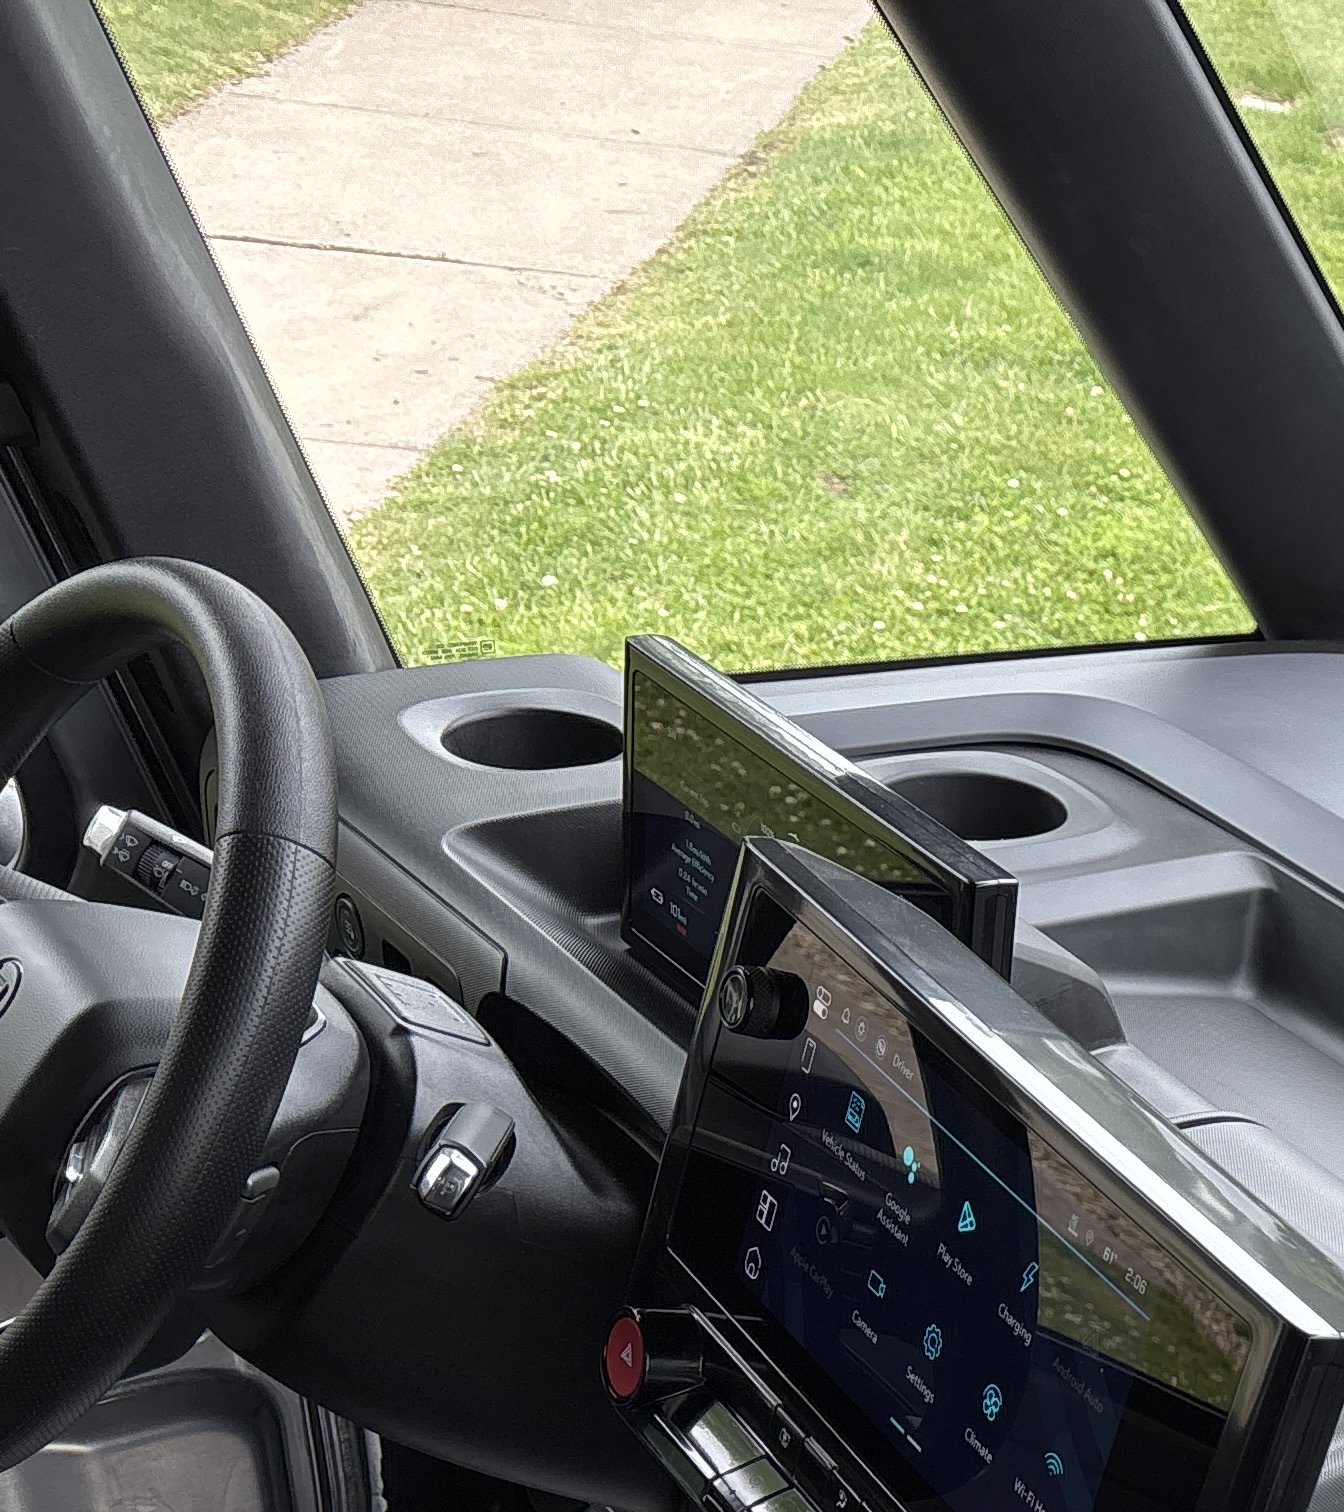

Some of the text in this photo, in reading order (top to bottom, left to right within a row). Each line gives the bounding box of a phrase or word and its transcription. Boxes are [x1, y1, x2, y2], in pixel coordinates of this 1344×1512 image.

[893, 1054, 914, 1081] Driver
[822, 1128, 867, 1182] Vehicle Status
[876, 1208, 909, 1248] Assistant
[885, 1192, 911, 1226] Google
[937, 1242, 973, 1287] Play Store
[1124, 1267, 1148, 1295] 2:06
[851, 1310, 879, 1345] Camera
[998, 1303, 1033, 1347] Charging
[905, 1365, 935, 1404] Settings
[1053, 1356, 1104, 1413] Android Auto
[964, 1427, 993, 1465] Climate
[1013, 1477, 1035, 1508] Wi-Fi
